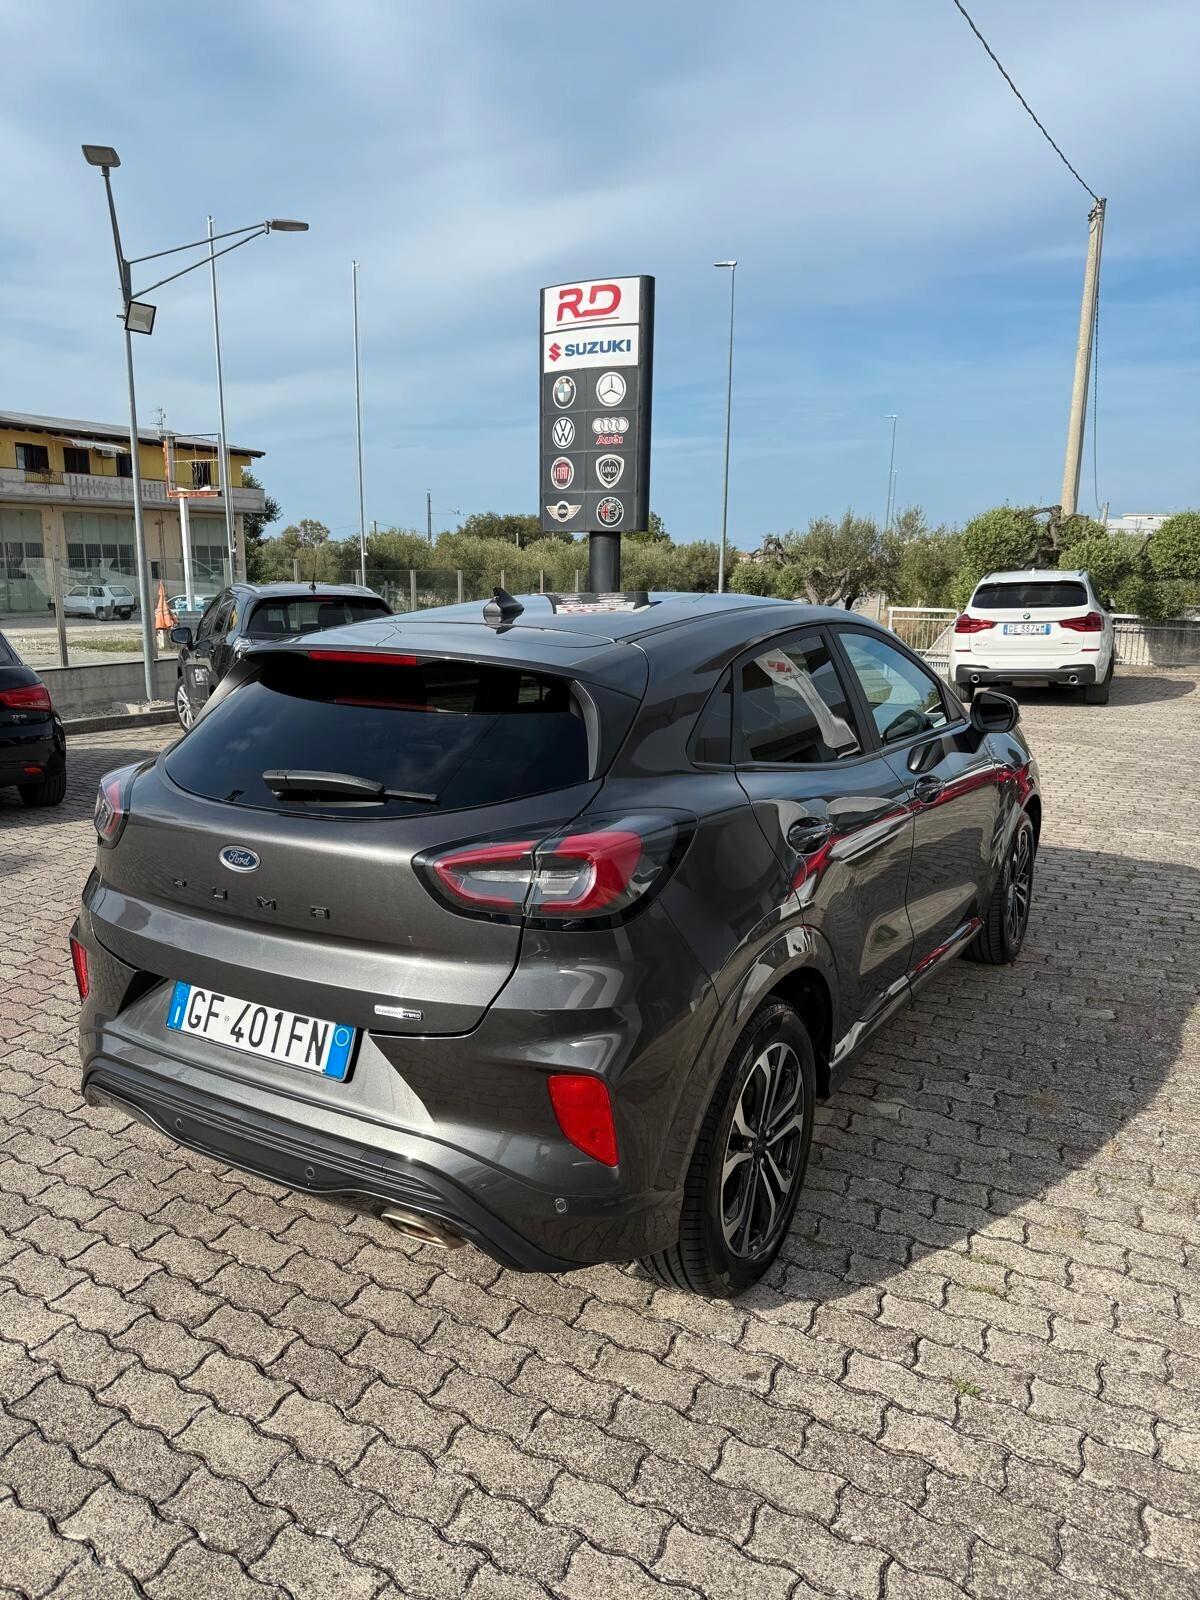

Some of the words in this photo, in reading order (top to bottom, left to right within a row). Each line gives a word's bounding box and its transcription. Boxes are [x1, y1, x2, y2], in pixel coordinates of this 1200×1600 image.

[557, 284, 622, 322] RD
[564, 339, 632, 357] SUZUKI
[595, 434, 624, 445] Audi
[557, 467, 568, 480] FIAT
[228, 849, 250, 866] Ford
[187, 990, 225, 1032] GF
[229, 1003, 330, 1066] 401FN
